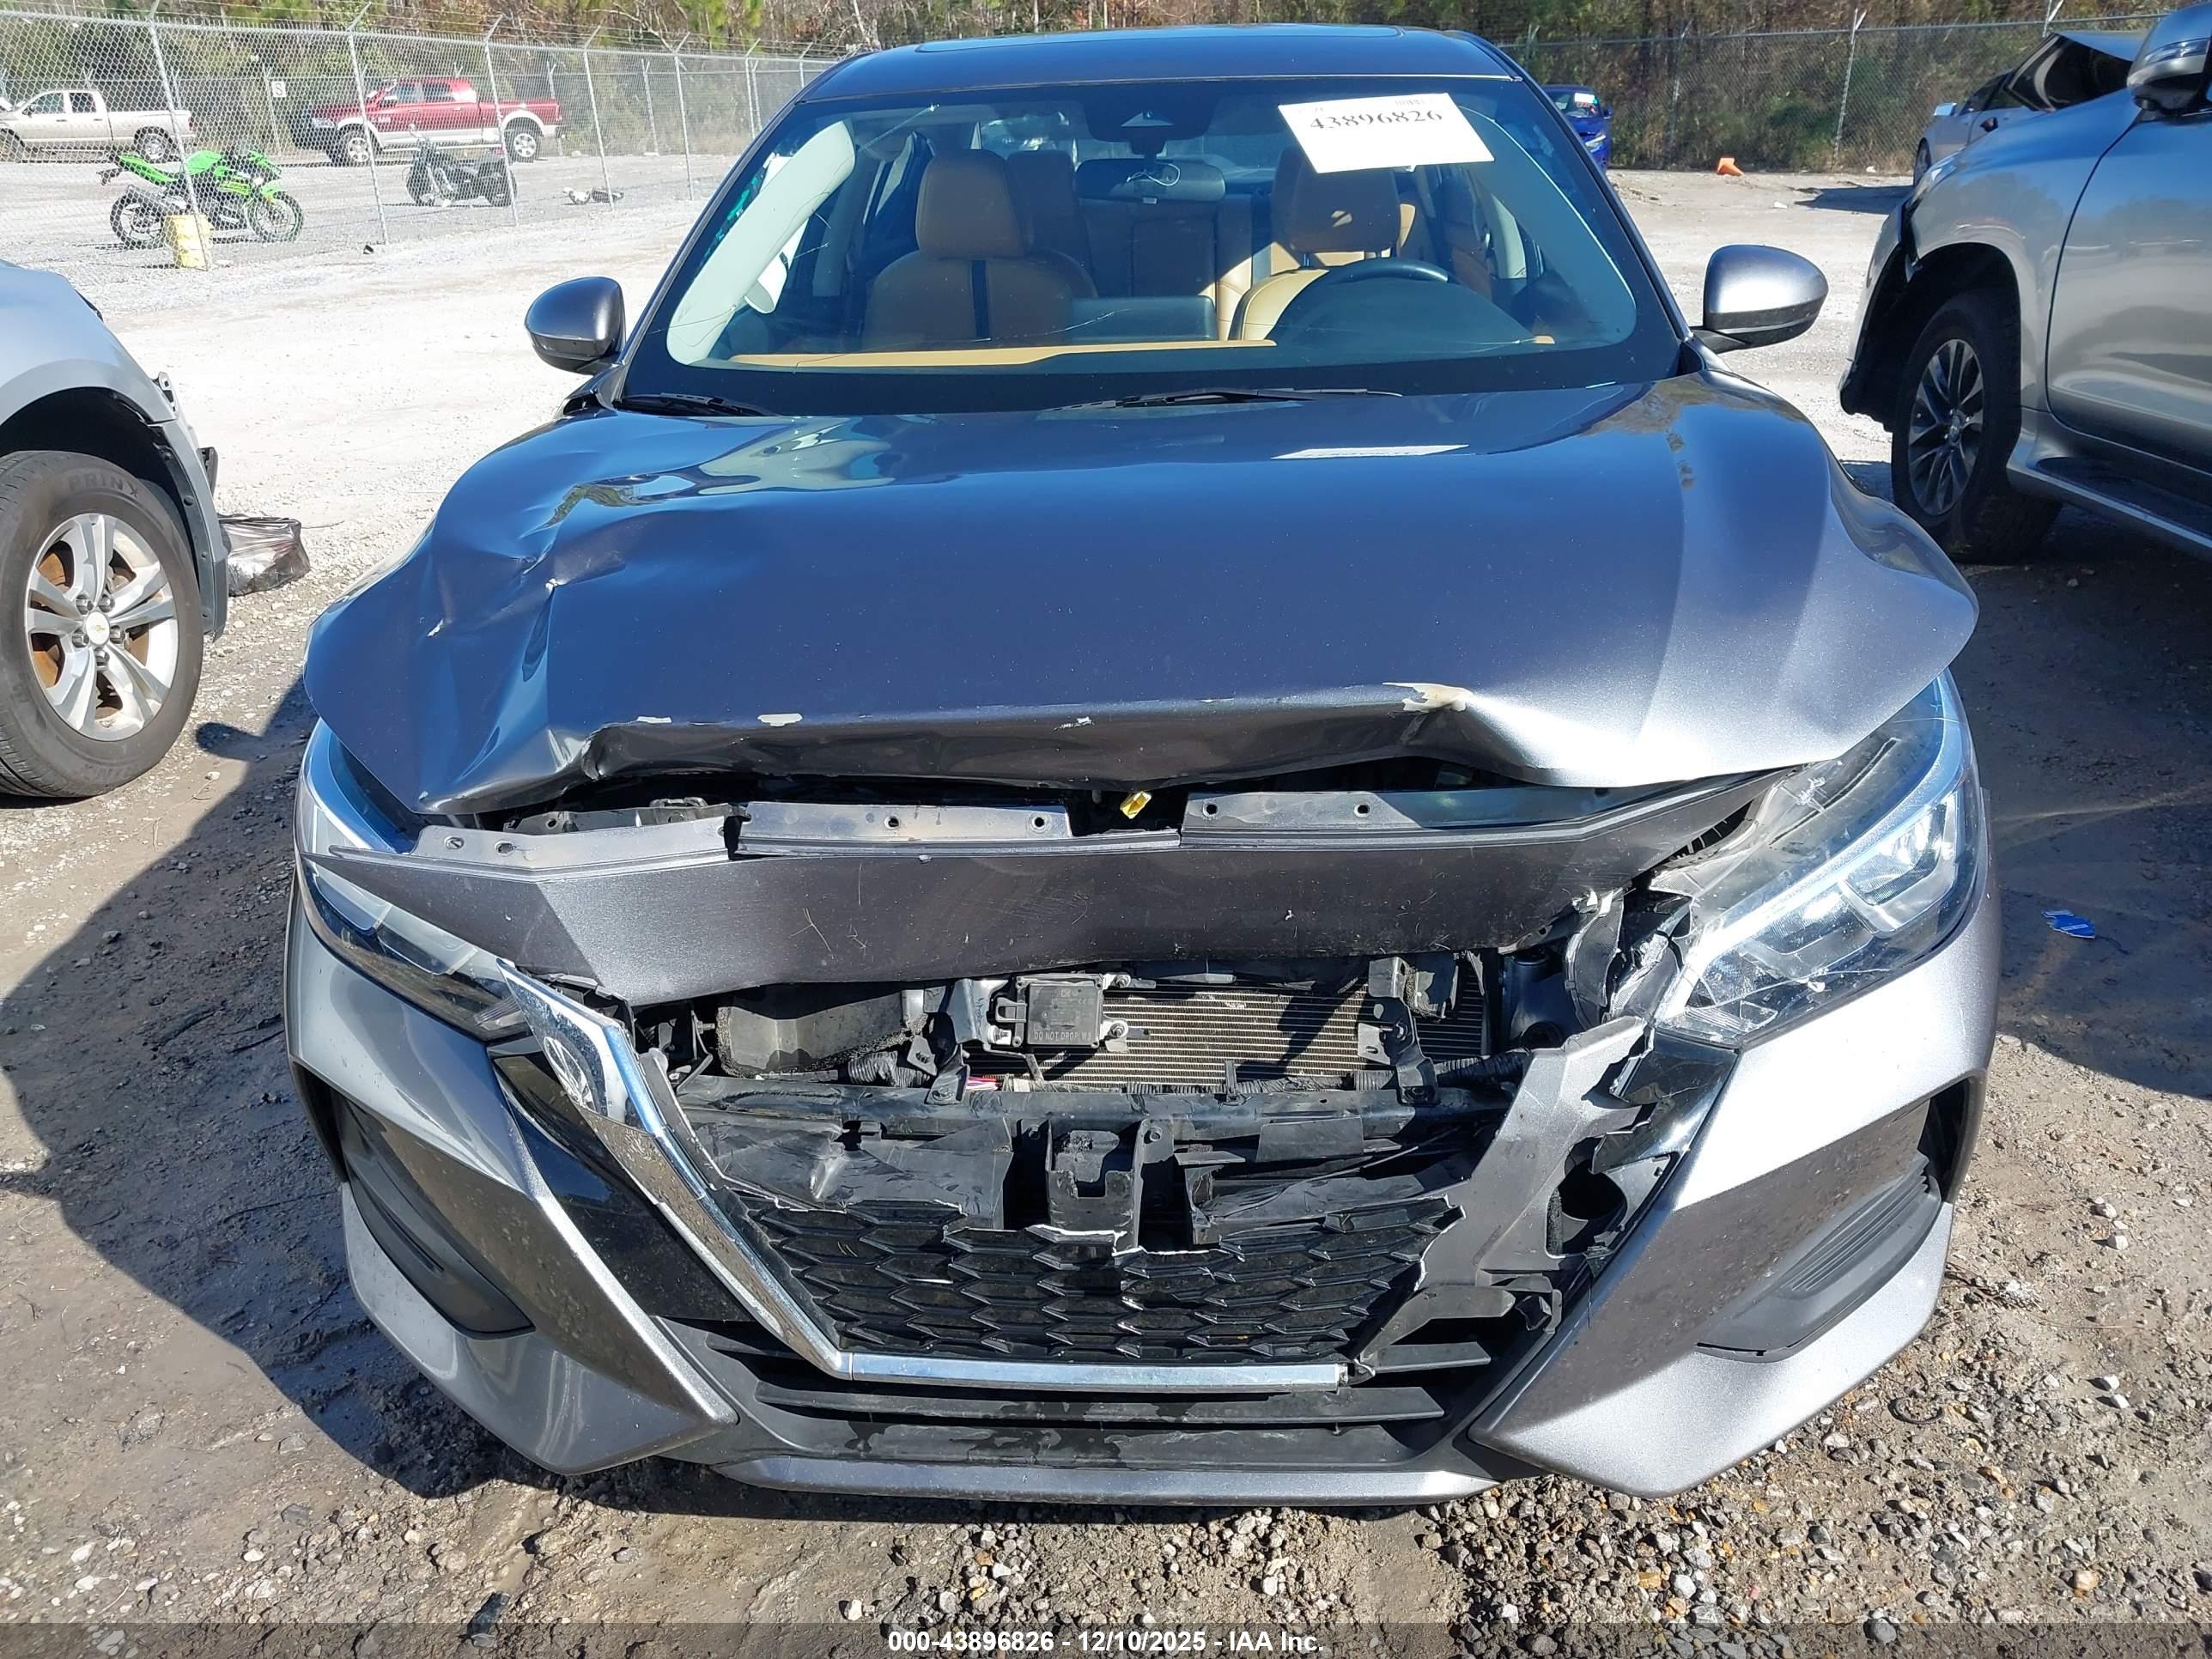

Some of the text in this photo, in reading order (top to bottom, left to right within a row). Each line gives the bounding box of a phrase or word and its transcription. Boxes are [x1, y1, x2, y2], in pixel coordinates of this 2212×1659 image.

[1310, 110, 1443, 129] 43896826
[68, 472, 138, 498] PRINX
[1034, 1031, 1043, 1042] DO
[1045, 1031, 1060, 1042] NOT
